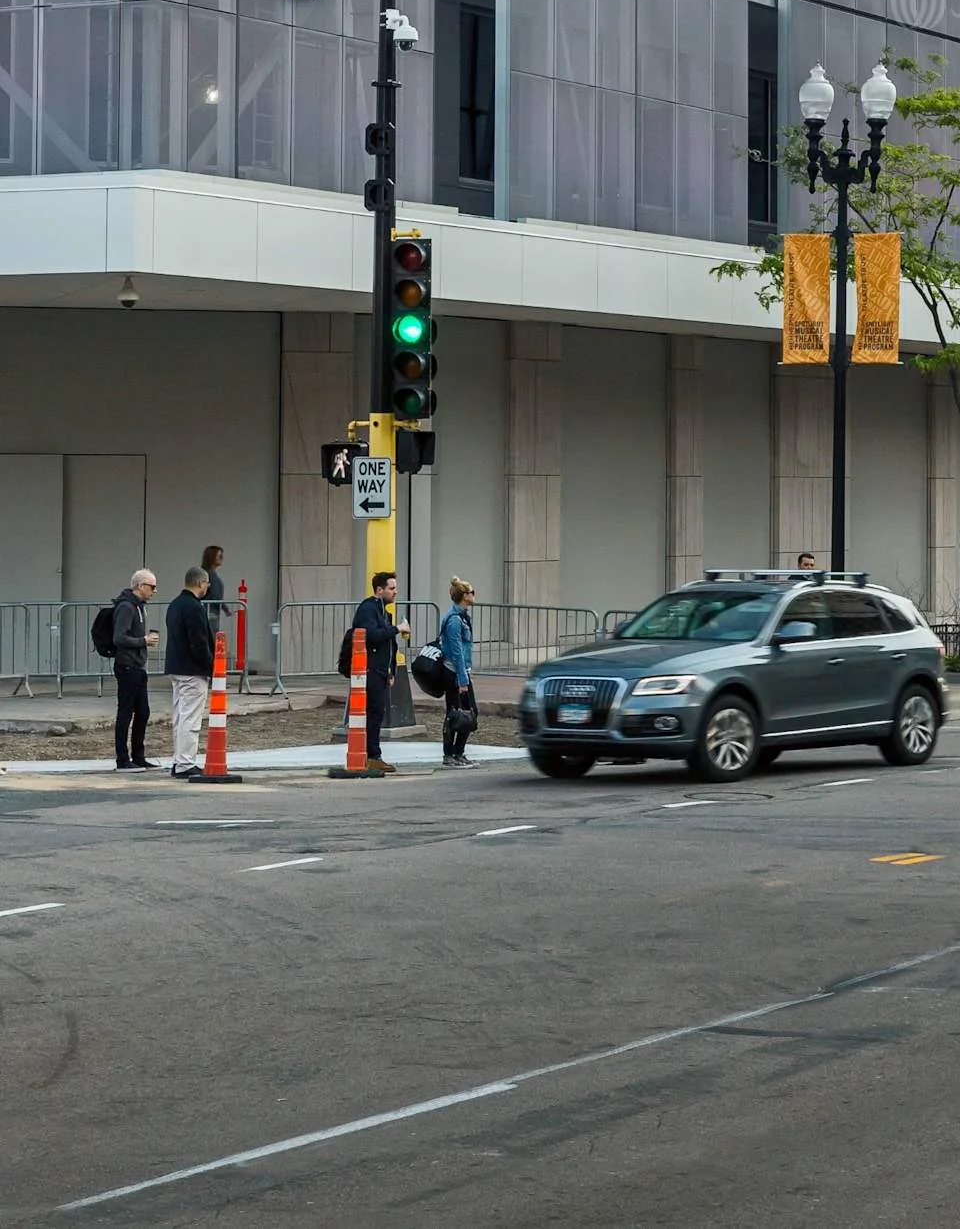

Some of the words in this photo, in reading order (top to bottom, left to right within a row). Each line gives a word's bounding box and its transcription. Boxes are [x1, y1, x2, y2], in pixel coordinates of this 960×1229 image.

[864, 335, 894, 343] THEATRE
[358, 461, 386, 476] ONE
[357, 479, 386, 493] WAY
